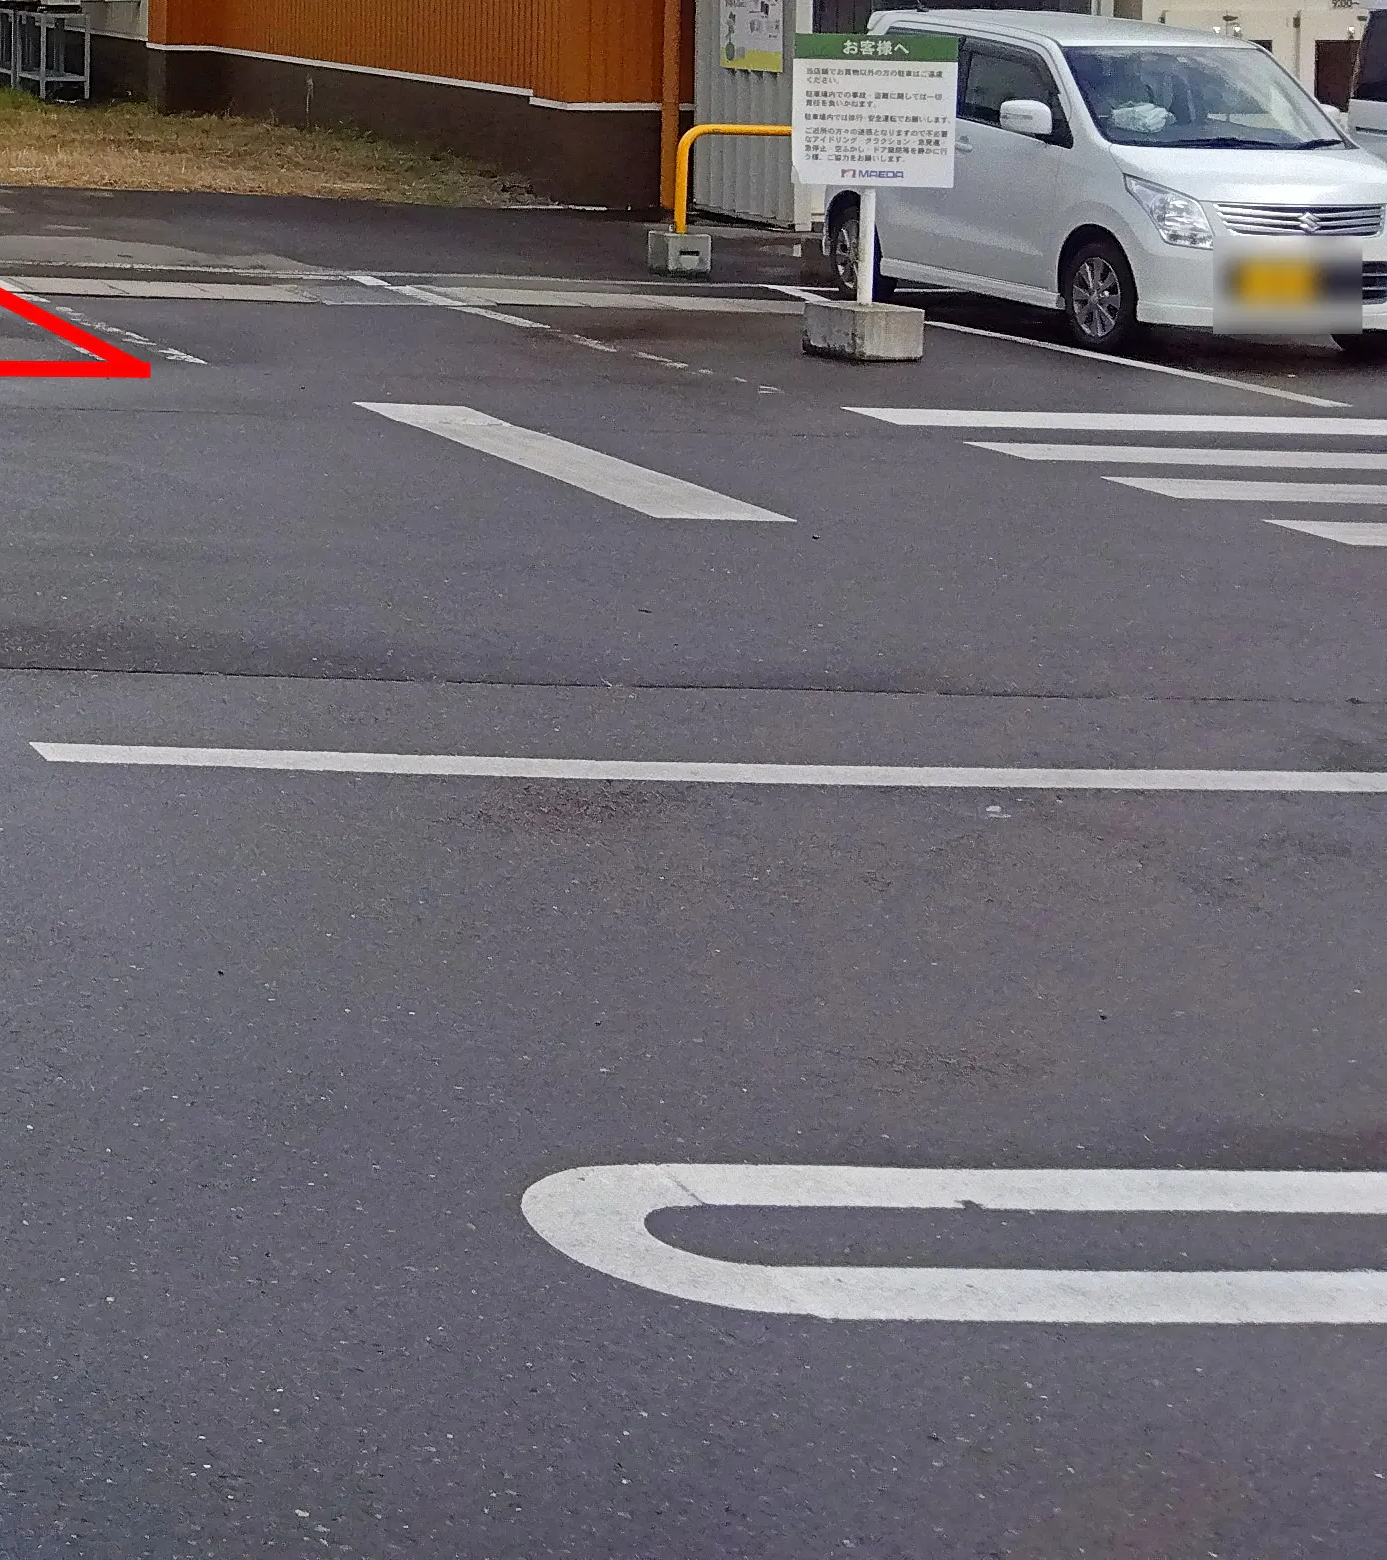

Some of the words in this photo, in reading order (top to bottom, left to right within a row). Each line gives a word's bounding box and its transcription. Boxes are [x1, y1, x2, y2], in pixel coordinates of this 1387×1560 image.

[842, 39, 911, 56] お客様へ
[858, 169, 905, 179] MAEDA
